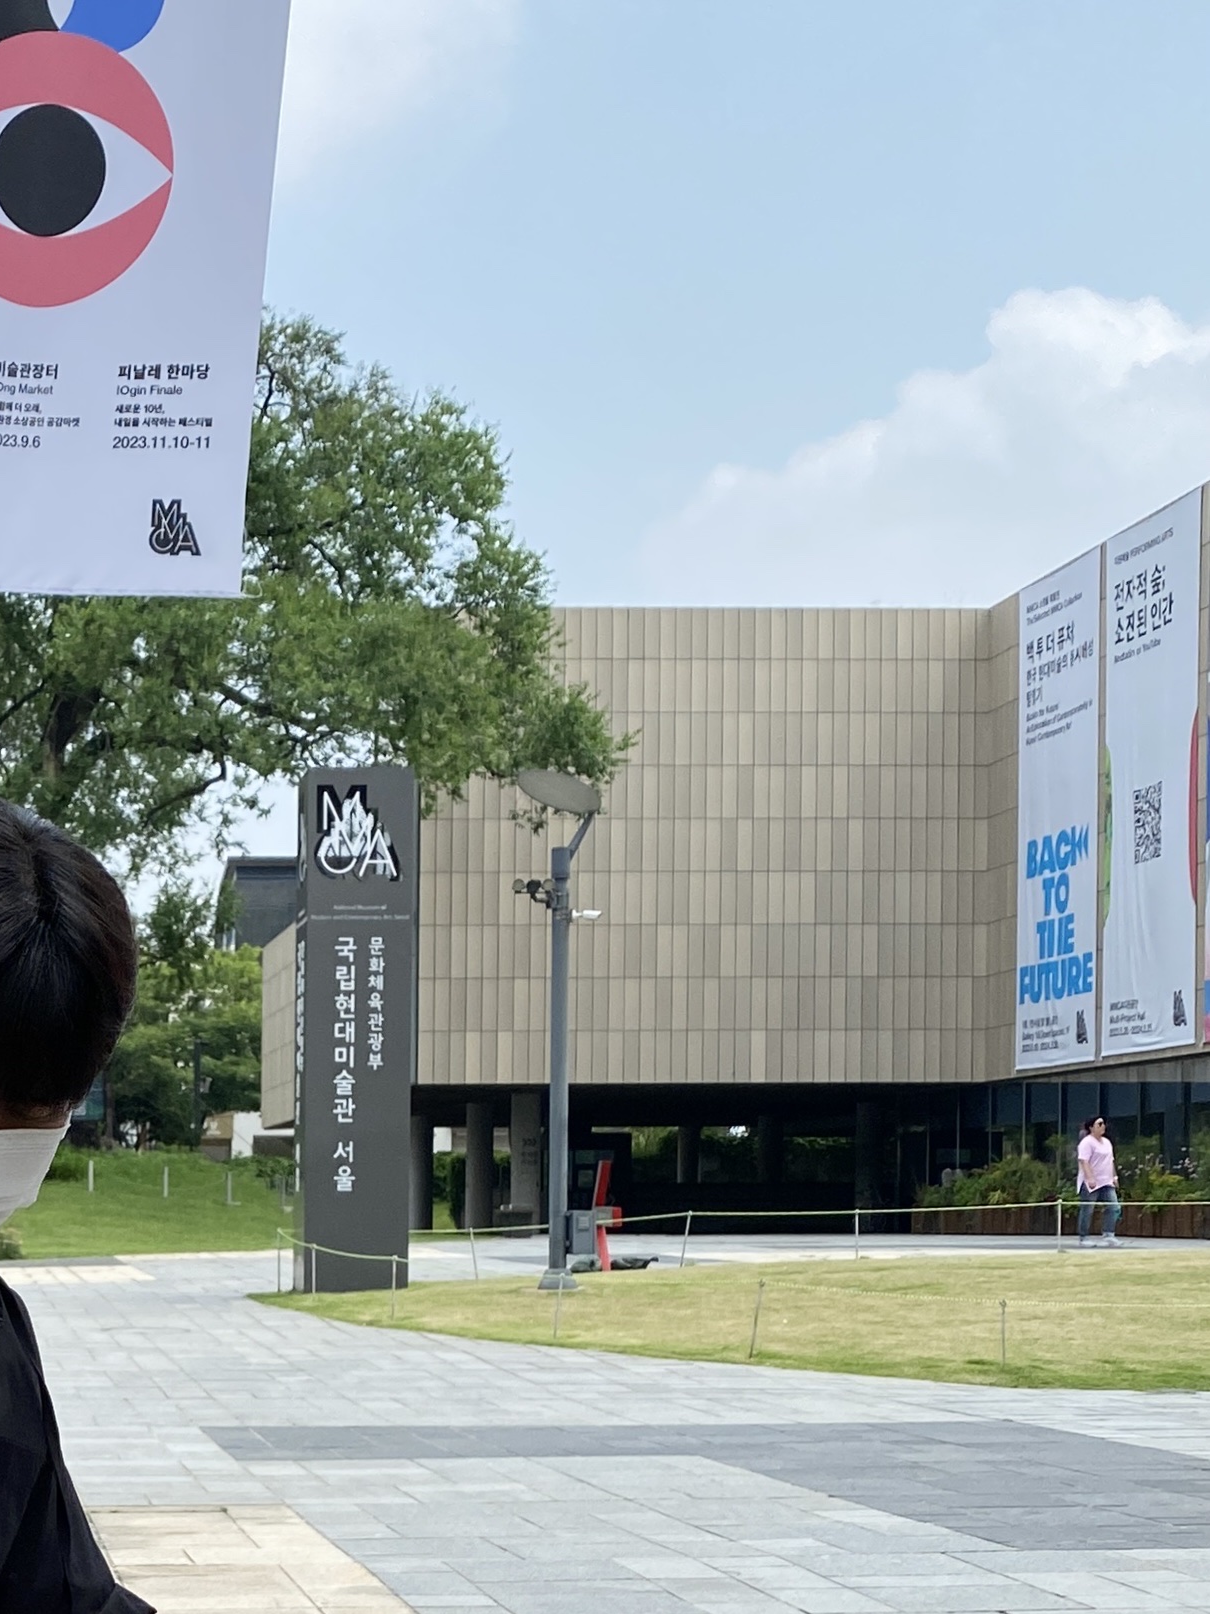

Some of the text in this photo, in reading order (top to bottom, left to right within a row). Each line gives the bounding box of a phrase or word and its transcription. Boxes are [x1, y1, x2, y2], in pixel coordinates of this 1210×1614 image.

[18, 383, 54, 395] Market
[118, 363, 211, 380] 피날레 한마당
[150, 384, 183, 396] Finale
[14, 402, 22, 413] 더
[142, 417, 177, 428] 시작하는
[112, 435, 211, 450] 2023.11.10-11
[148, 498, 202, 557] MMCA
[1114, 569, 1148, 612] 전자적
[1114, 591, 1174, 645] 소진된 인간
[1036, 634, 1044, 661] 투
[1046, 630, 1056, 655] 더
[317, 785, 400, 882] MMCA
[1042, 872, 1070, 917] TO
[1019, 951, 1094, 1006] FUTURE
[367, 936, 385, 1071] 문화체육관광부
[333, 936, 357, 1192] 국립현대미술관 서울
